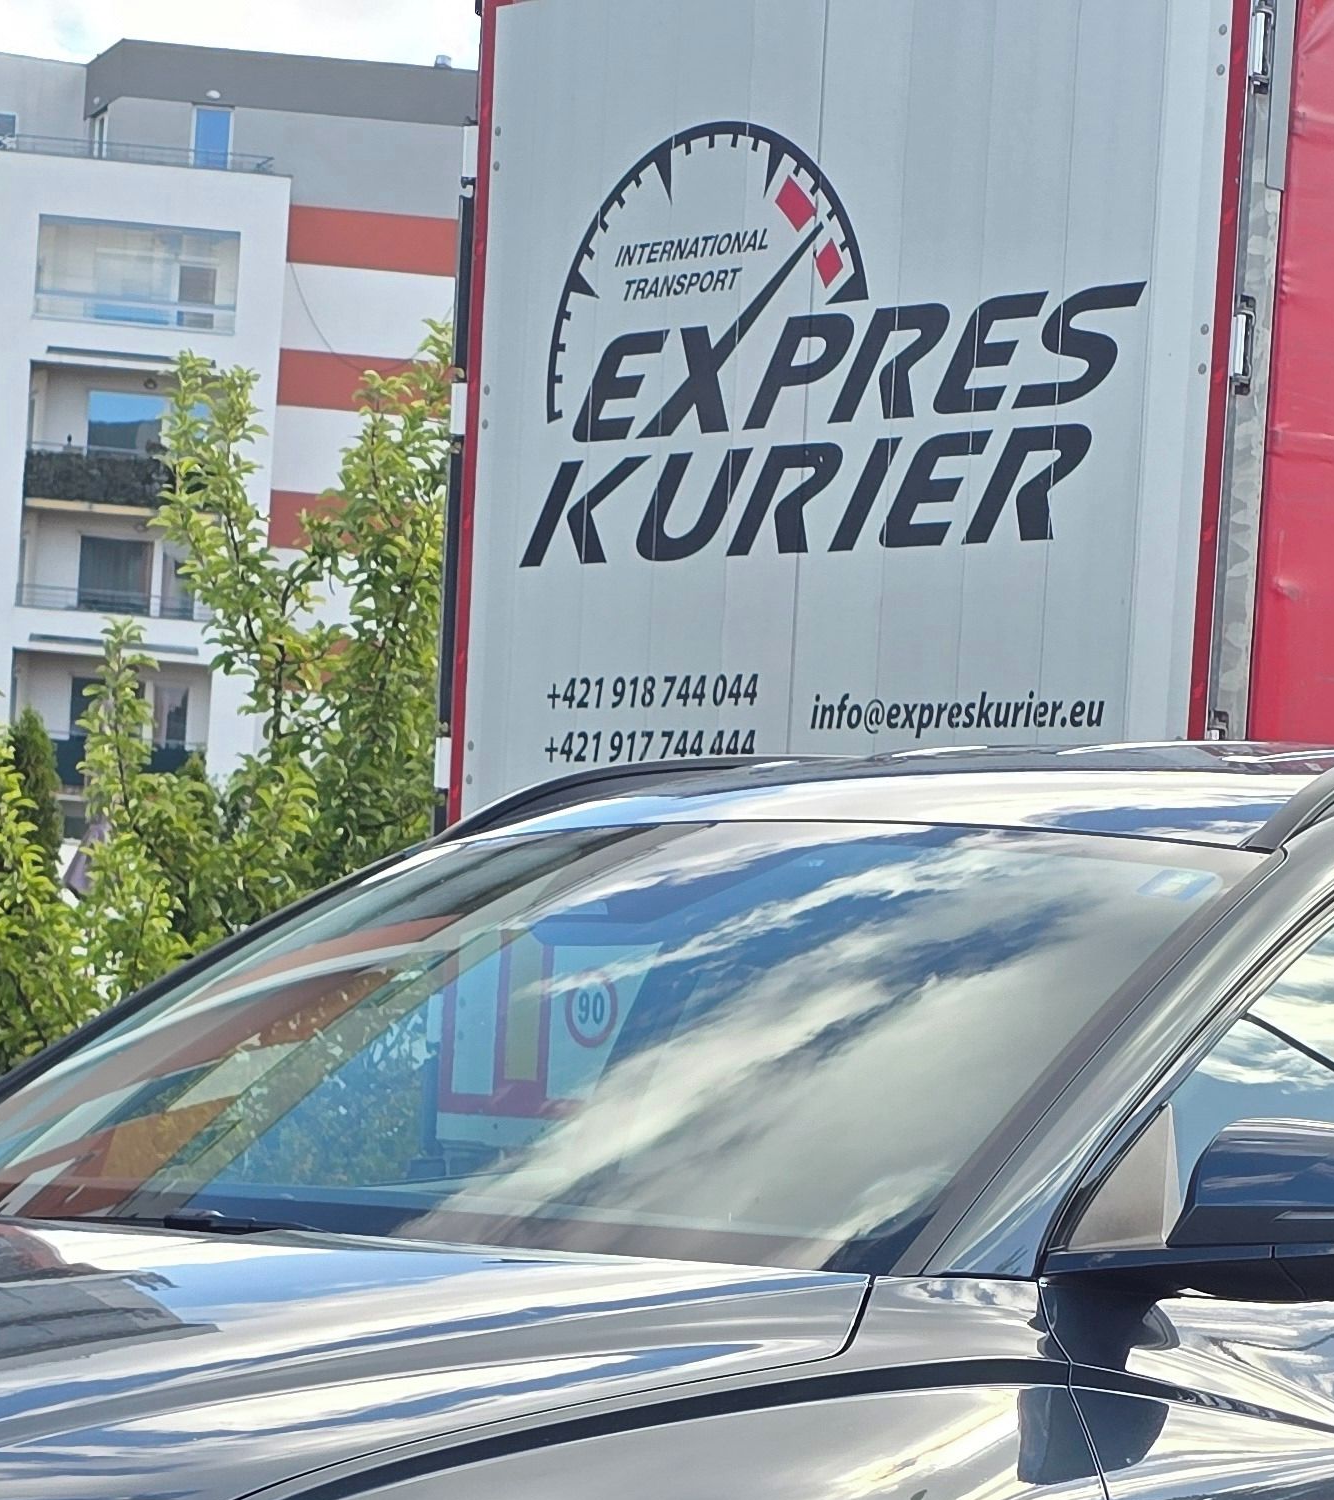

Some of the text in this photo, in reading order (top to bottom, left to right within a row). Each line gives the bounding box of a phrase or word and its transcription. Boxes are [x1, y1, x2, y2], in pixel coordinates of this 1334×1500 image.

[615, 228, 768, 267] INTERNATIONAL
[623, 267, 742, 301] TRANSPORT
[572, 281, 1147, 443] EXPRES
[519, 422, 1093, 569] KURIER
[547, 673, 759, 709] +421 918 744 044
[810, 691, 1105, 738] info@expreskurier.eu
[545, 729, 756, 762] +421 917 744 444
[577, 991, 606, 1025] 90
